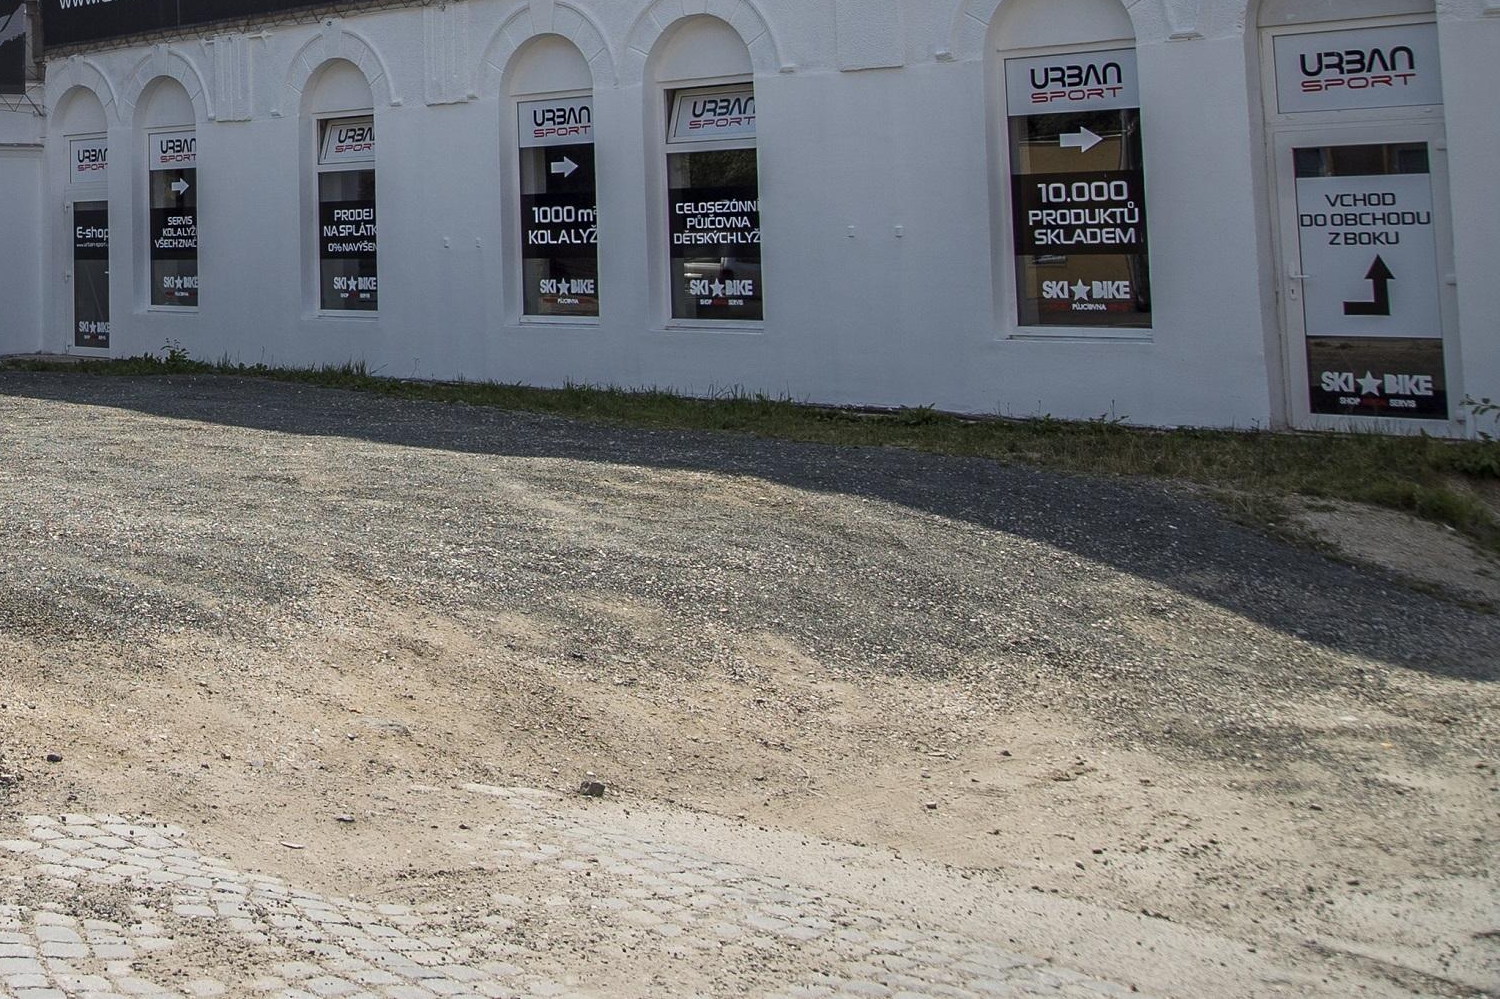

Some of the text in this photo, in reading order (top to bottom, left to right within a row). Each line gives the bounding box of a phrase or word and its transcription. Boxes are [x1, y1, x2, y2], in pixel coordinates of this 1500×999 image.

[1300, 45, 1416, 77] URBAN
[1030, 62, 1123, 89] URBAN
[1300, 73, 1417, 93] SPORT
[1031, 87, 1124, 104] SPORT
[692, 97, 756, 118] URBAN
[533, 105, 591, 127] URBAN
[688, 116, 756, 130] SPORT
[337, 127, 375, 143] URBA
[533, 125, 591, 138] SPORT
[160, 138, 197, 154] URBAN
[335, 143, 375, 153] SPOR
[160, 153, 197, 163] SPORT
[1037, 181, 1128, 203] 10.000
[1325, 192, 1396, 207] VCHOD
[167, 216, 193, 226] SERVIS
[334, 208, 374, 221] PRODEJ
[532, 206, 575, 223] 1000
[686, 213, 751, 229] PŮJČOVNA
[1028, 201, 1139, 226] PRODUKTŮ
[1300, 211, 1431, 227] DO OBCHODU
[76, 226, 108, 241] E-shop
[323, 222, 378, 237] NA SPLÁTK
[528, 224, 597, 245] KOLA LYŽ
[673, 228, 761, 245] DĚTSKÝCH LYŽ
[1034, 227, 1136, 245] SKLADEM
[342, 240, 377, 252] NAVÝŠEN
[1328, 231, 1400, 245] Z BOKU
[333, 276, 377, 291] SKI BIKE
[540, 279, 595, 294] SKI BIKE
[690, 279, 754, 296] SKI BIKE
[1042, 280, 1131, 299] SKI BIKE
[1321, 371, 1434, 396] SKI BIKE
